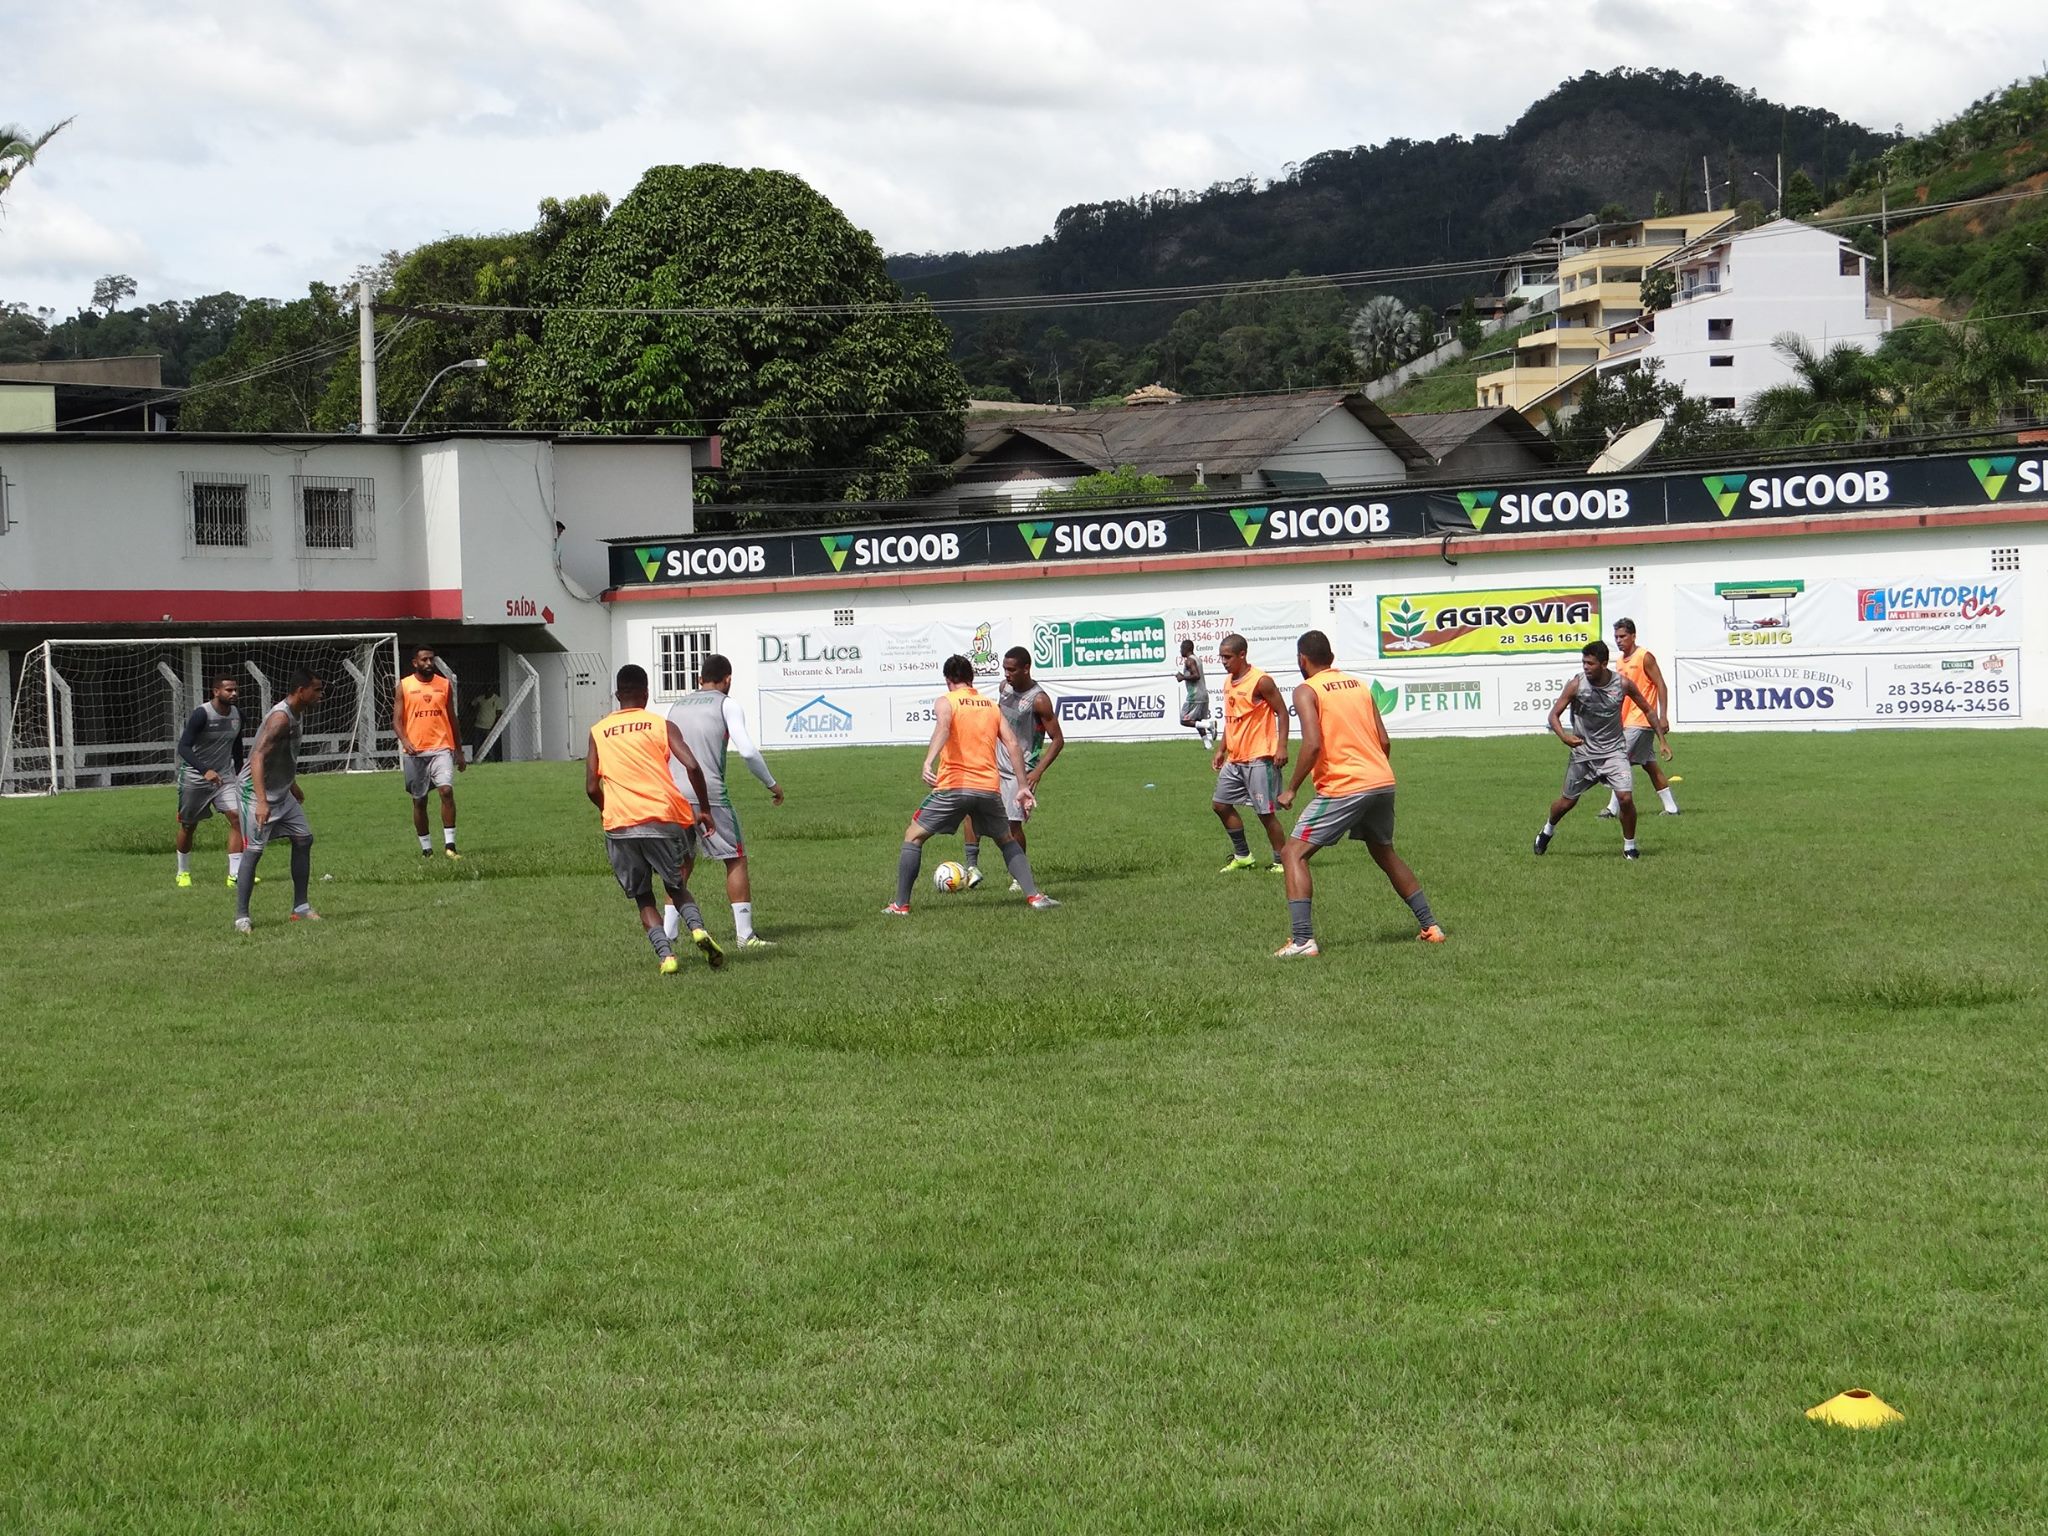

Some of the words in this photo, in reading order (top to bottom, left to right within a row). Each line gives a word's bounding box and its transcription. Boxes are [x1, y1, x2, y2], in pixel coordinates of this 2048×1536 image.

[1749, 471, 1890, 510] SICOOB
[1500, 488, 1630, 525] SICOOB
[1269, 503, 1390, 539] SICOOB
[1055, 519, 1168, 553] SICOOB
[854, 533, 960, 566] SICOOB
[667, 545, 766, 576] SICOOB
[1887, 585, 1998, 609] VENTORIM
[506, 595, 537, 617] SAÍDA
[1961, 597, 2006, 621] Car
[1173, 620, 1190, 631] (28)
[1191, 618, 1235, 629] 3546-3777
[1435, 602, 1591, 631] AGROVIA
[1110, 626, 1164, 643] Santa
[1499, 634, 1515, 645] 28
[1523, 633, 1554, 644] 3546
[1558, 632, 1588, 643] 1615
[1728, 631, 1793, 646] ESMIG
[758, 634, 790, 663] Di
[797, 633, 862, 662] Luca
[1075, 643, 1165, 662] Terezinha
[782, 666, 823, 677] Ristorante
[824, 666, 833, 675] &
[835, 665, 863, 675] Parada
[879, 663, 896, 672] (28)
[1322, 679, 1360, 692] VETTOR
[1405, 682, 1481, 693] VIVEIRO
[1526, 682, 1542, 692] 28
[1688, 668, 1779, 694] DISTRIBUIDORA
[1783, 668, 1800, 679] DE
[1803, 670, 1853, 691] BEBIDAS
[1888, 685, 1906, 696] 28
[1910, 680, 2010, 695] 3546-2865
[958, 698, 993, 708] VETTOR
[1117, 695, 1166, 711] PNEUS
[1405, 692, 1481, 712] PERIM
[1513, 701, 1529, 711] 28
[1714, 686, 1834, 711] PRIMOS
[1876, 703, 1894, 714] 28
[1897, 698, 2010, 713] 99984-3456
[906, 712, 920, 722] 28
[1120, 711, 1136, 719] Auto
[1137, 710, 1160, 719] Center
[603, 721, 652, 738] VETTOR
